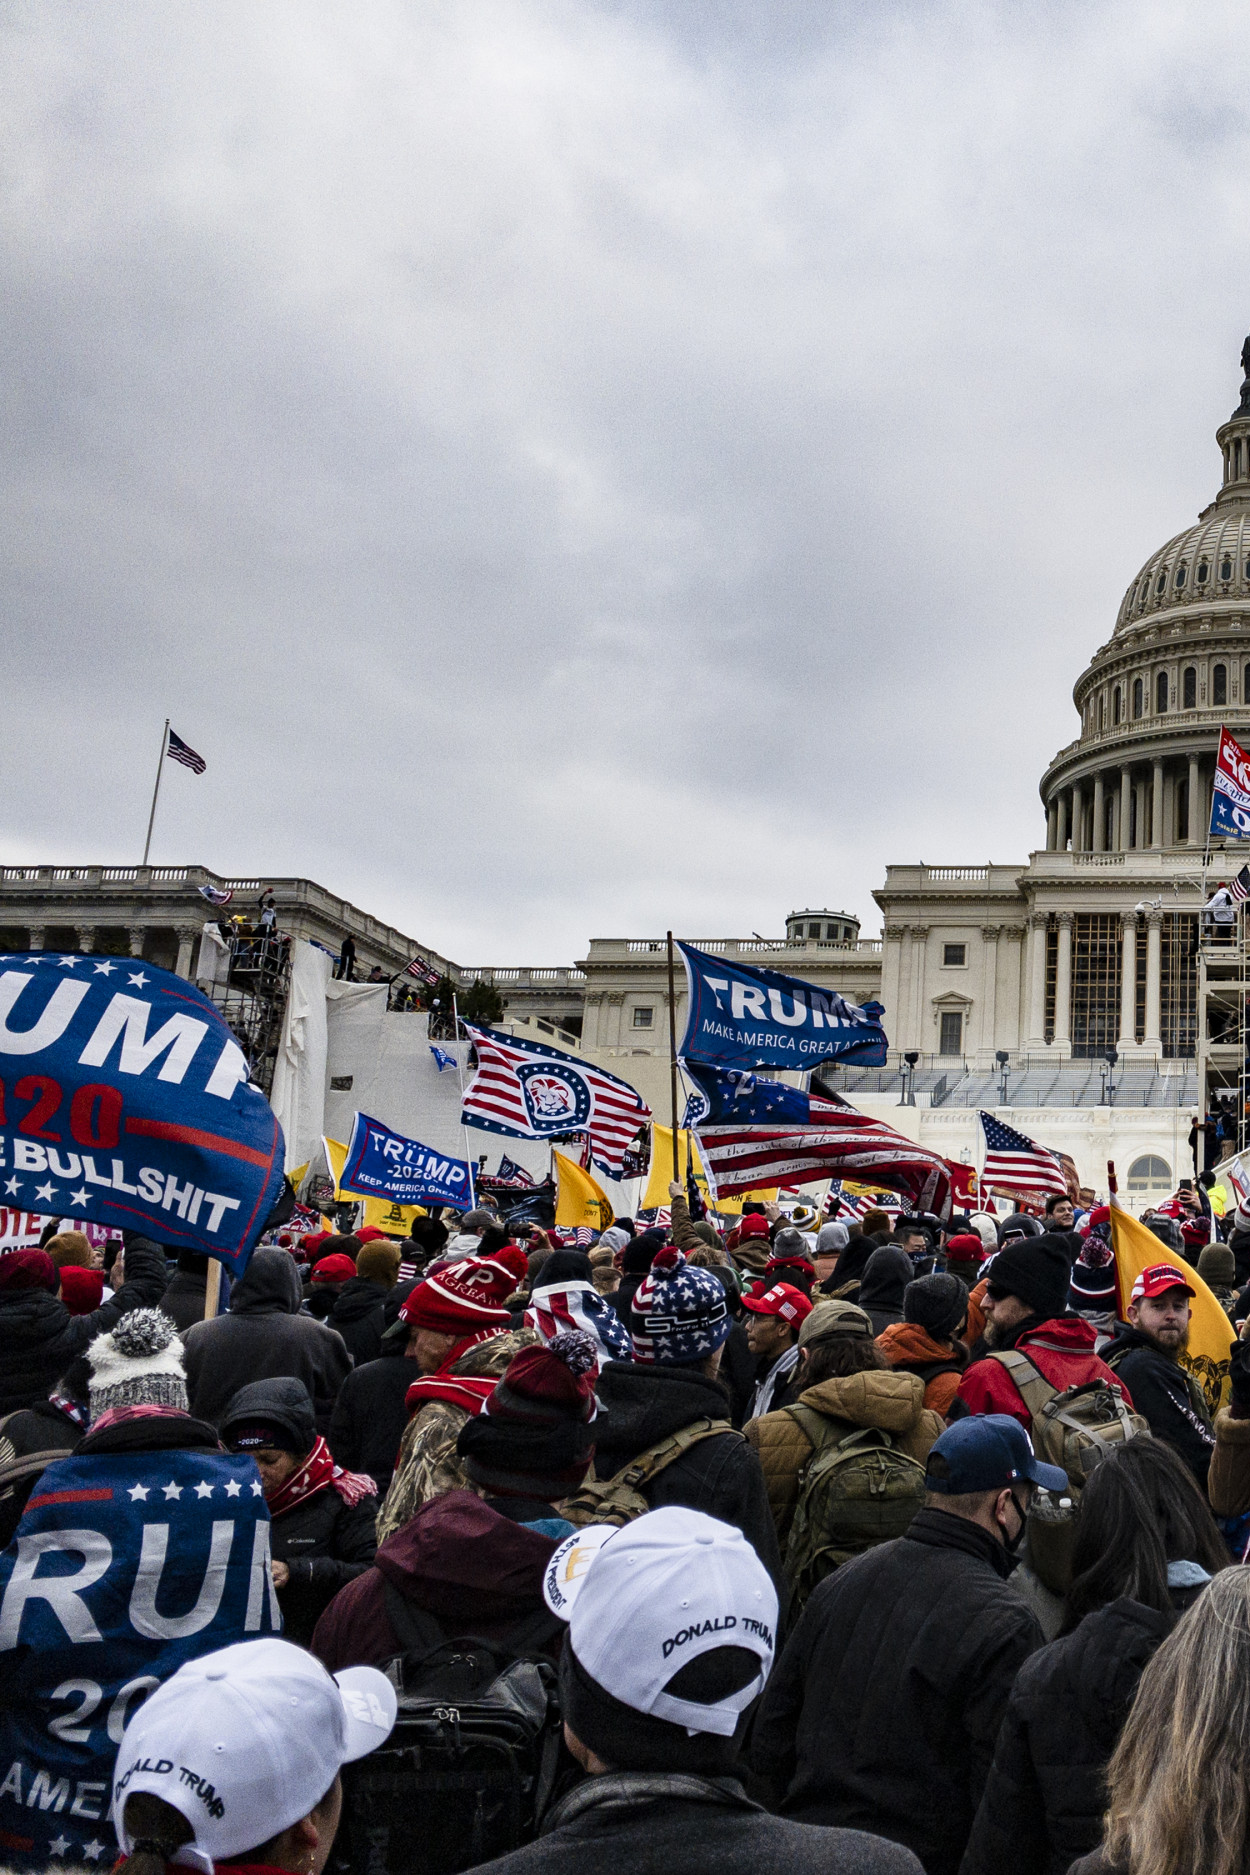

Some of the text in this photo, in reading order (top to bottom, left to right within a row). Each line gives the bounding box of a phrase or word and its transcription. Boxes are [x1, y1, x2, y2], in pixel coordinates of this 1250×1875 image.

[703, 1019, 735, 1041] MAKE
[736, 1031, 795, 1050] AMERICA
[799, 1040, 841, 1054] GREAT
[0, 1073, 124, 1149] 20
[358, 1172, 382, 1186] KEEP
[384, 1182, 426, 1193] AMERICA
[369, 1130, 466, 1186] TRUMP
[13, 1138, 241, 1233] BULLSHIT
[661, 1615, 737, 1660] DONALD
[179, 1766, 226, 1820] TRUMP
